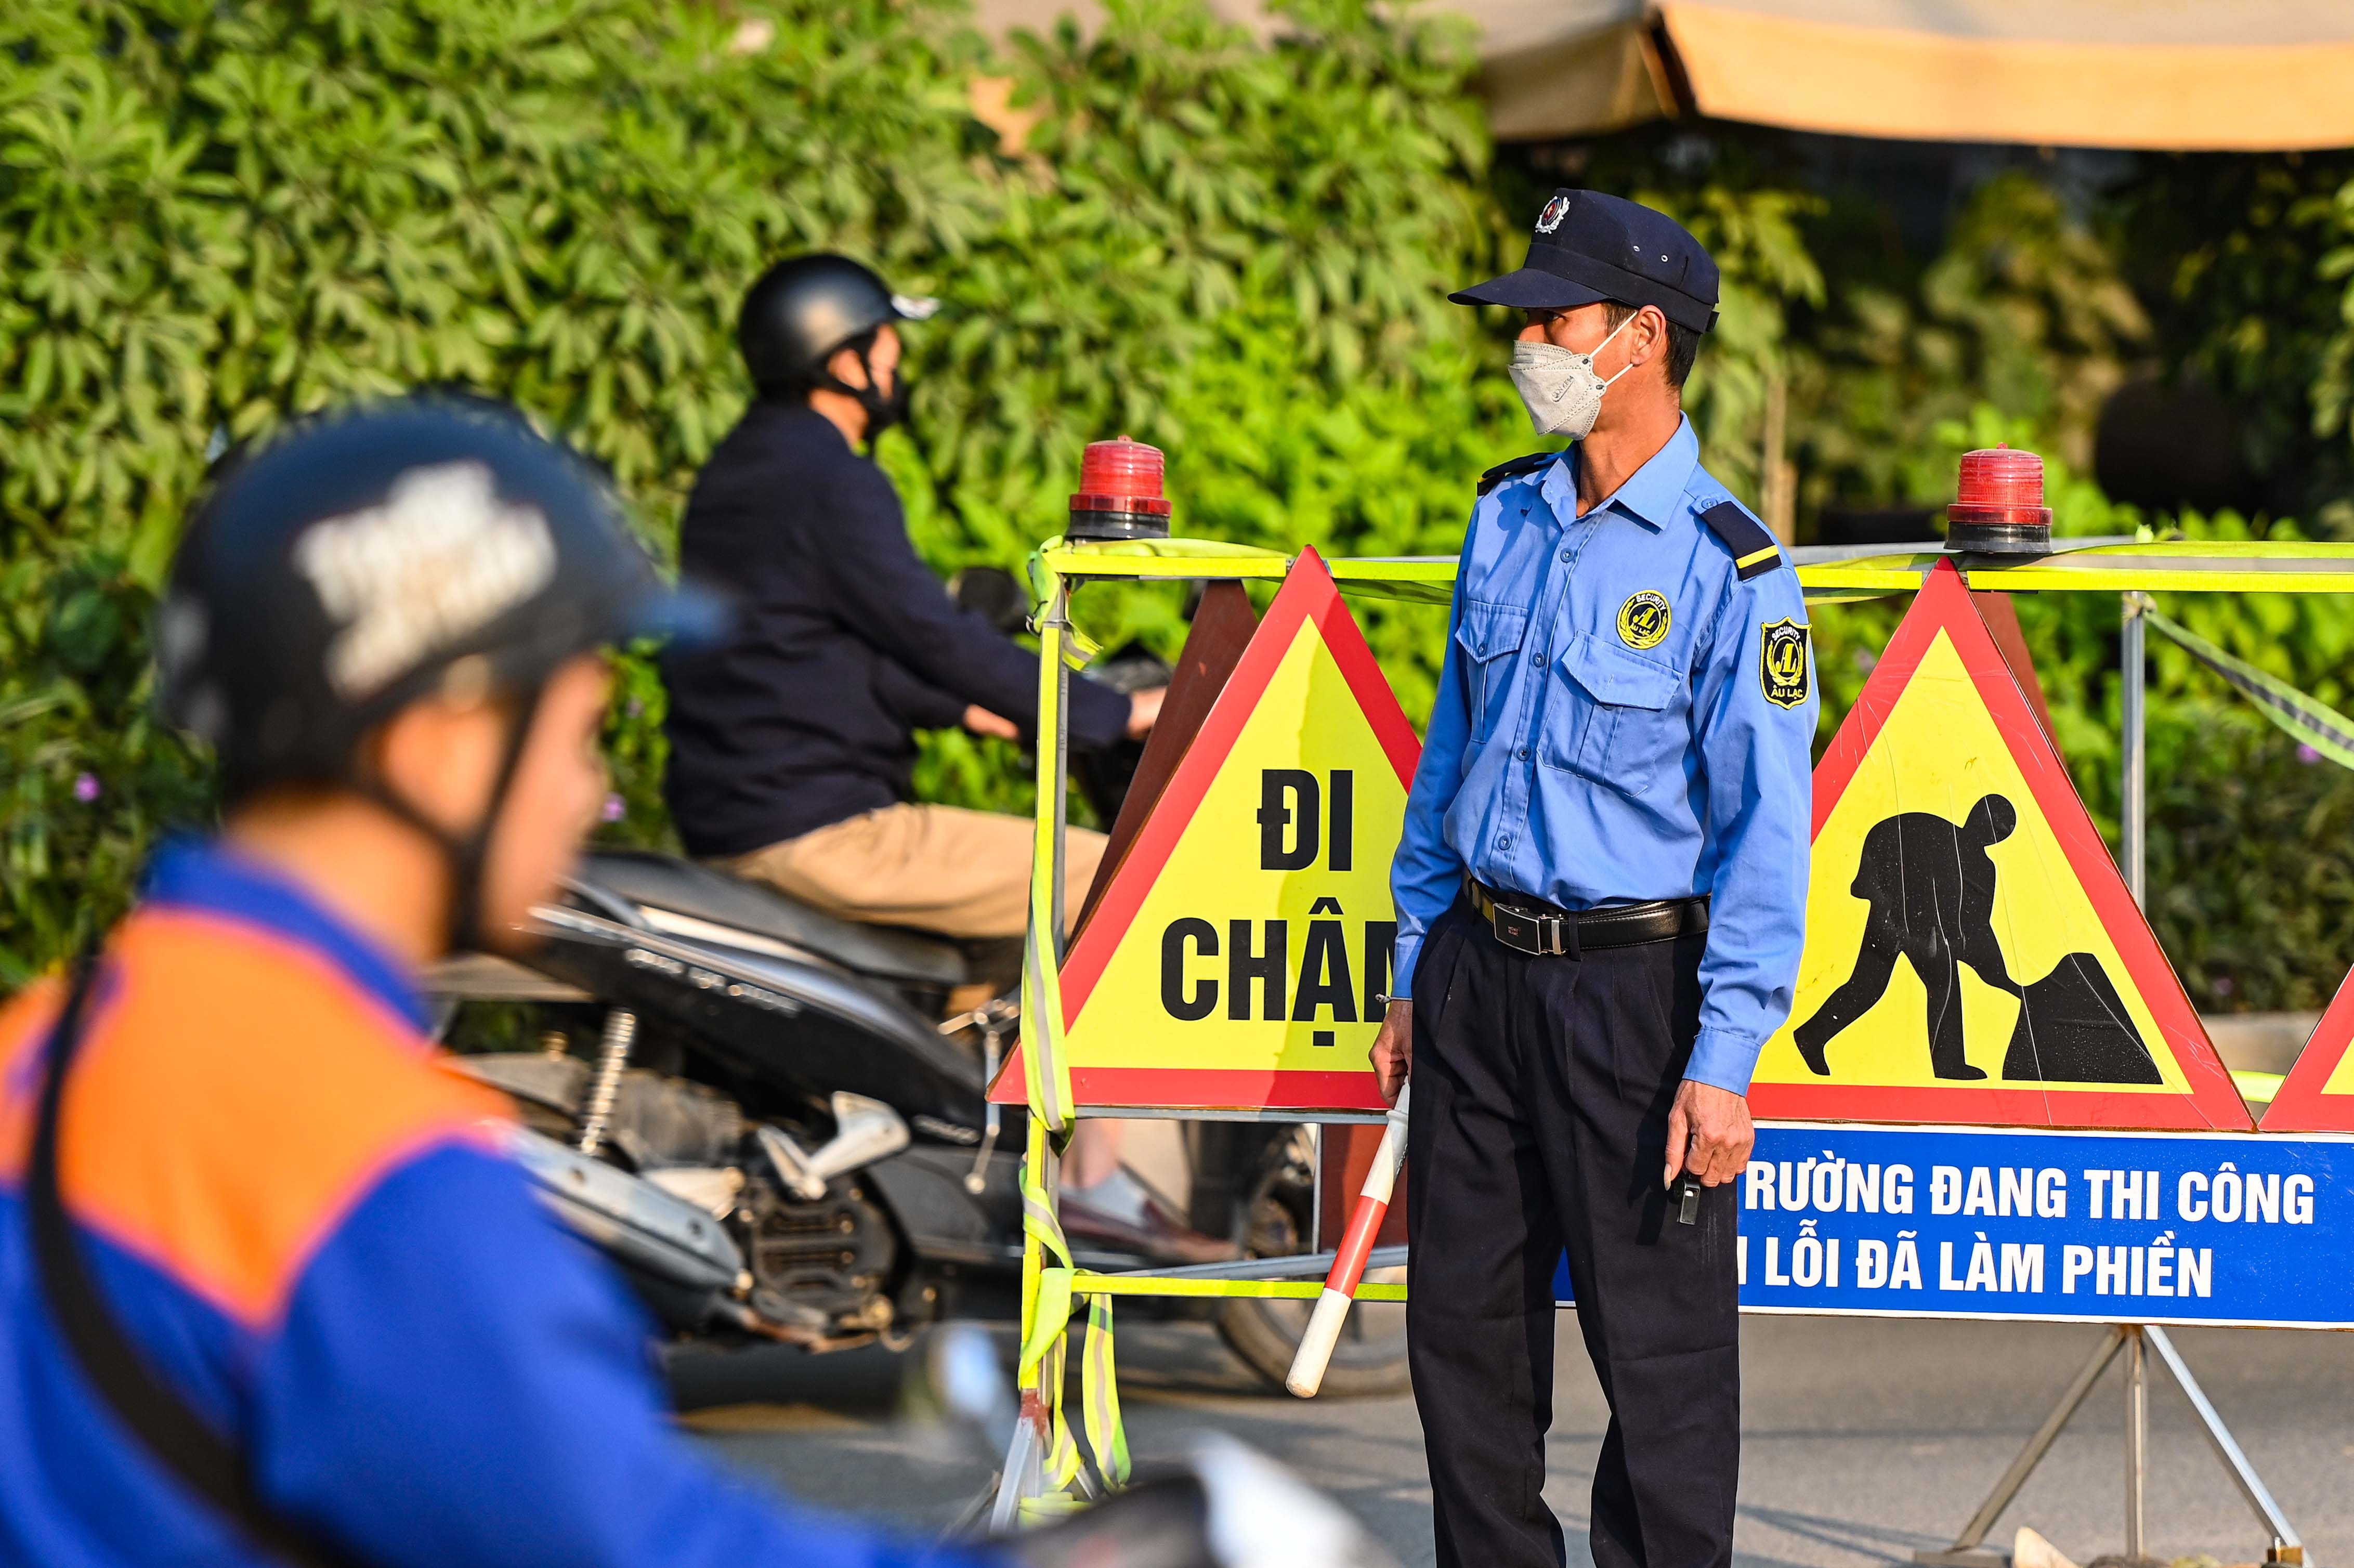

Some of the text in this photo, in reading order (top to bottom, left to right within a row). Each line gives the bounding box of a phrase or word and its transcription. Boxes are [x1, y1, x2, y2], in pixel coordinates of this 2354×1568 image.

[1636, 593, 1666, 610] SECURITY
[1772, 626, 1801, 641] SECURITY
[1771, 684, 1803, 699] ÂU LẠC
[1257, 769, 1353, 871] ĐI
[1745, 1150, 2314, 1224] RƯỜNG ĐANG THI CÔNG
[1765, 1219, 1839, 1287] LỖI
[1855, 1230, 1923, 1289] ĐÃ
[1939, 1232, 2044, 1293] LÀM
[2062, 1231, 2213, 1298] PHIỀN
